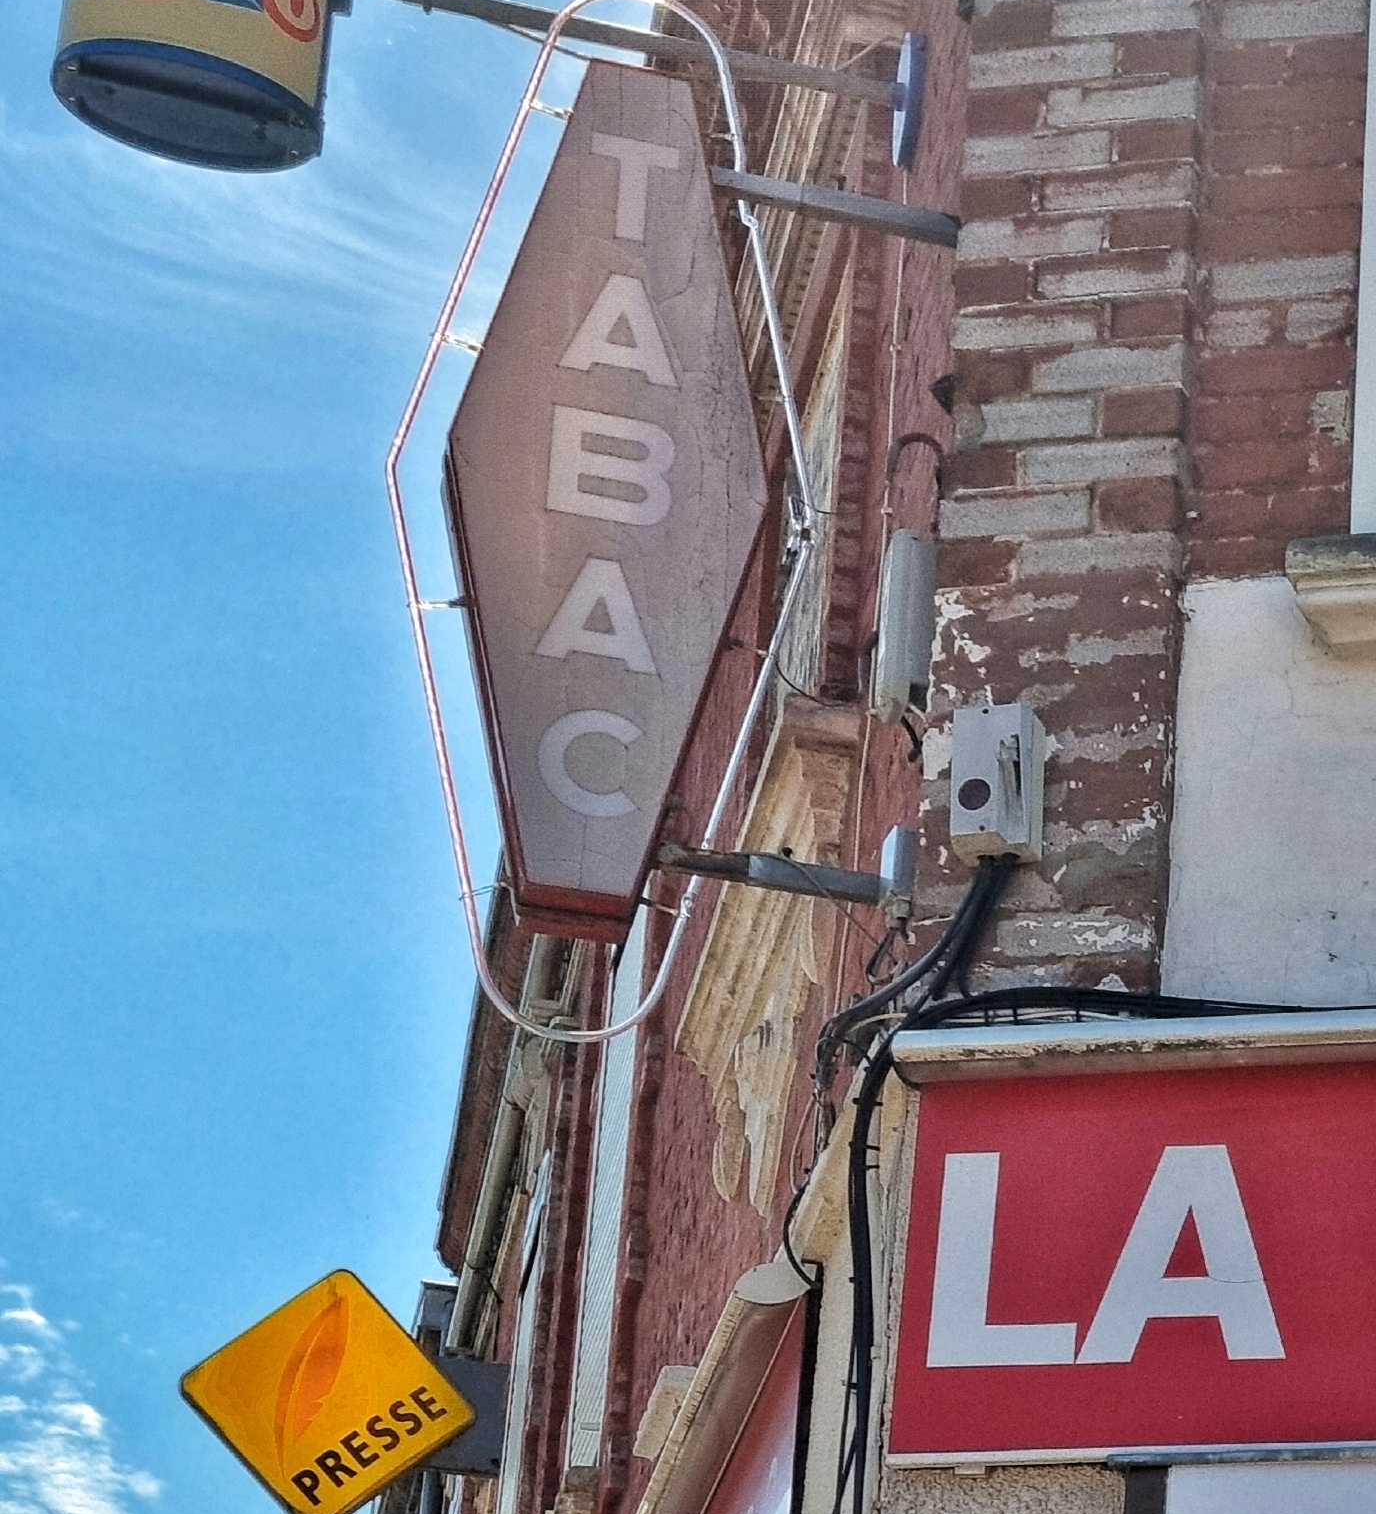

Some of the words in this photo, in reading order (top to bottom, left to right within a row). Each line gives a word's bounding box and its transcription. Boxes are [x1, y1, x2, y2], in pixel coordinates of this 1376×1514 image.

[536, 131, 682, 818] TABAC
[925, 1142, 1287, 1368] LA
[290, 1386, 448, 1507] PRESSE
